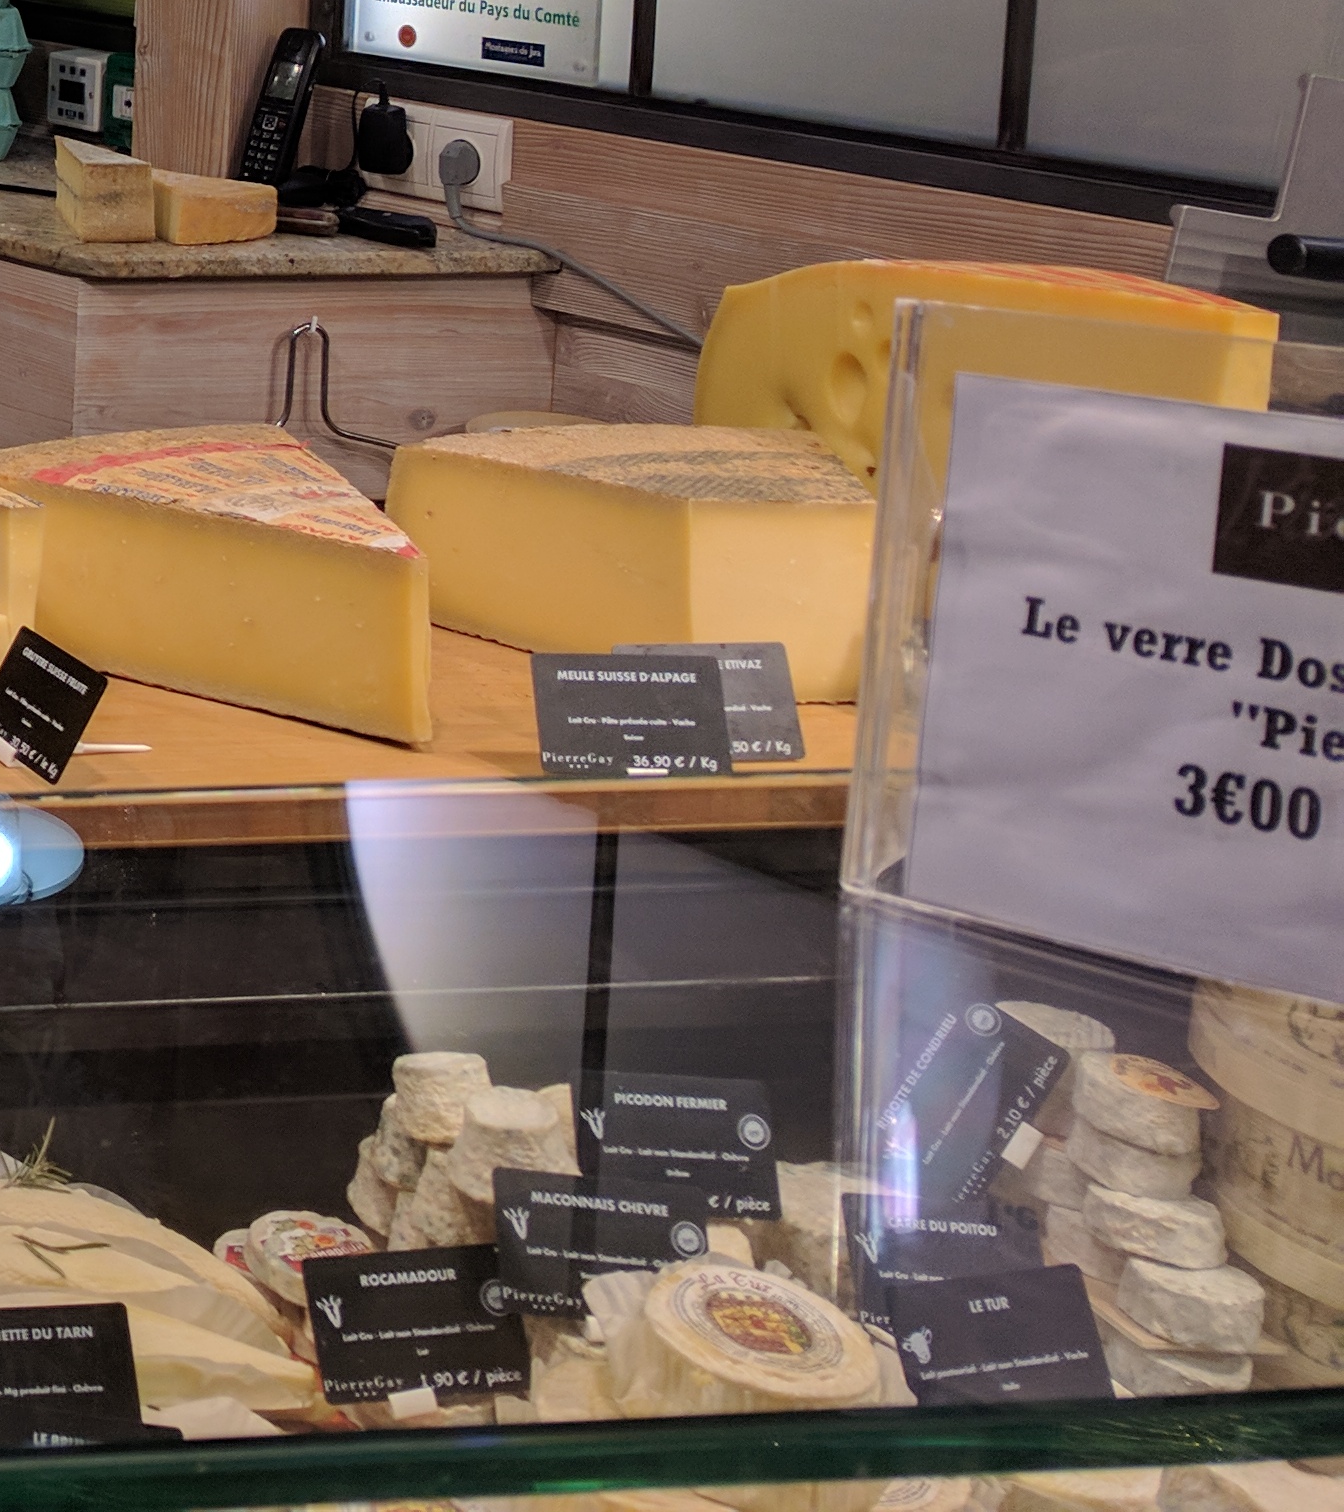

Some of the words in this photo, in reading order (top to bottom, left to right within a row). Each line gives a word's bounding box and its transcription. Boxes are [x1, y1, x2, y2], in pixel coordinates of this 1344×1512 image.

[480, 0, 508, 21] Pays
[513, 4, 530, 20] du
[535, 7, 580, 28] Comté
[1022, 596, 1080, 643] Le
[1105, 621, 1232, 671] verre
[725, 659, 762, 670] ETIVAZ
[557, 669, 595, 682] MEULE
[597, 671, 637, 682] SUISSE
[639, 671, 697, 684] D'ALPAGE
[542, 751, 613, 766] PierreGay
[674, 756, 685, 768] €
[701, 756, 717, 772] Kg
[1174, 762, 1322, 841] 3€00
[906, 1069, 922, 1087] DE
[916, 1012, 957, 1071] CONDRIEU
[1033, 1055, 1058, 1089] pièce
[614, 1092, 674, 1108] PICODON
[676, 1097, 728, 1111] FERMIER
[531, 1191, 616, 1212] MACONNAIS
[618, 1196, 669, 1218] CHEVRE
[736, 1196, 770, 1213] pièce
[929, 1219, 948, 1233] DU
[950, 1222, 998, 1237] POITOU
[359, 1268, 457, 1288] ROCAMADOUR
[502, 1286, 583, 1310] PierreGay
[968, 1300, 984, 1313] LE
[985, 1296, 1010, 1312] TUR
[32, 1328, 51, 1340] DU
[57, 1326, 94, 1338] TARN
[324, 1375, 404, 1393] PierreGay
[485, 1367, 522, 1385] pièce
